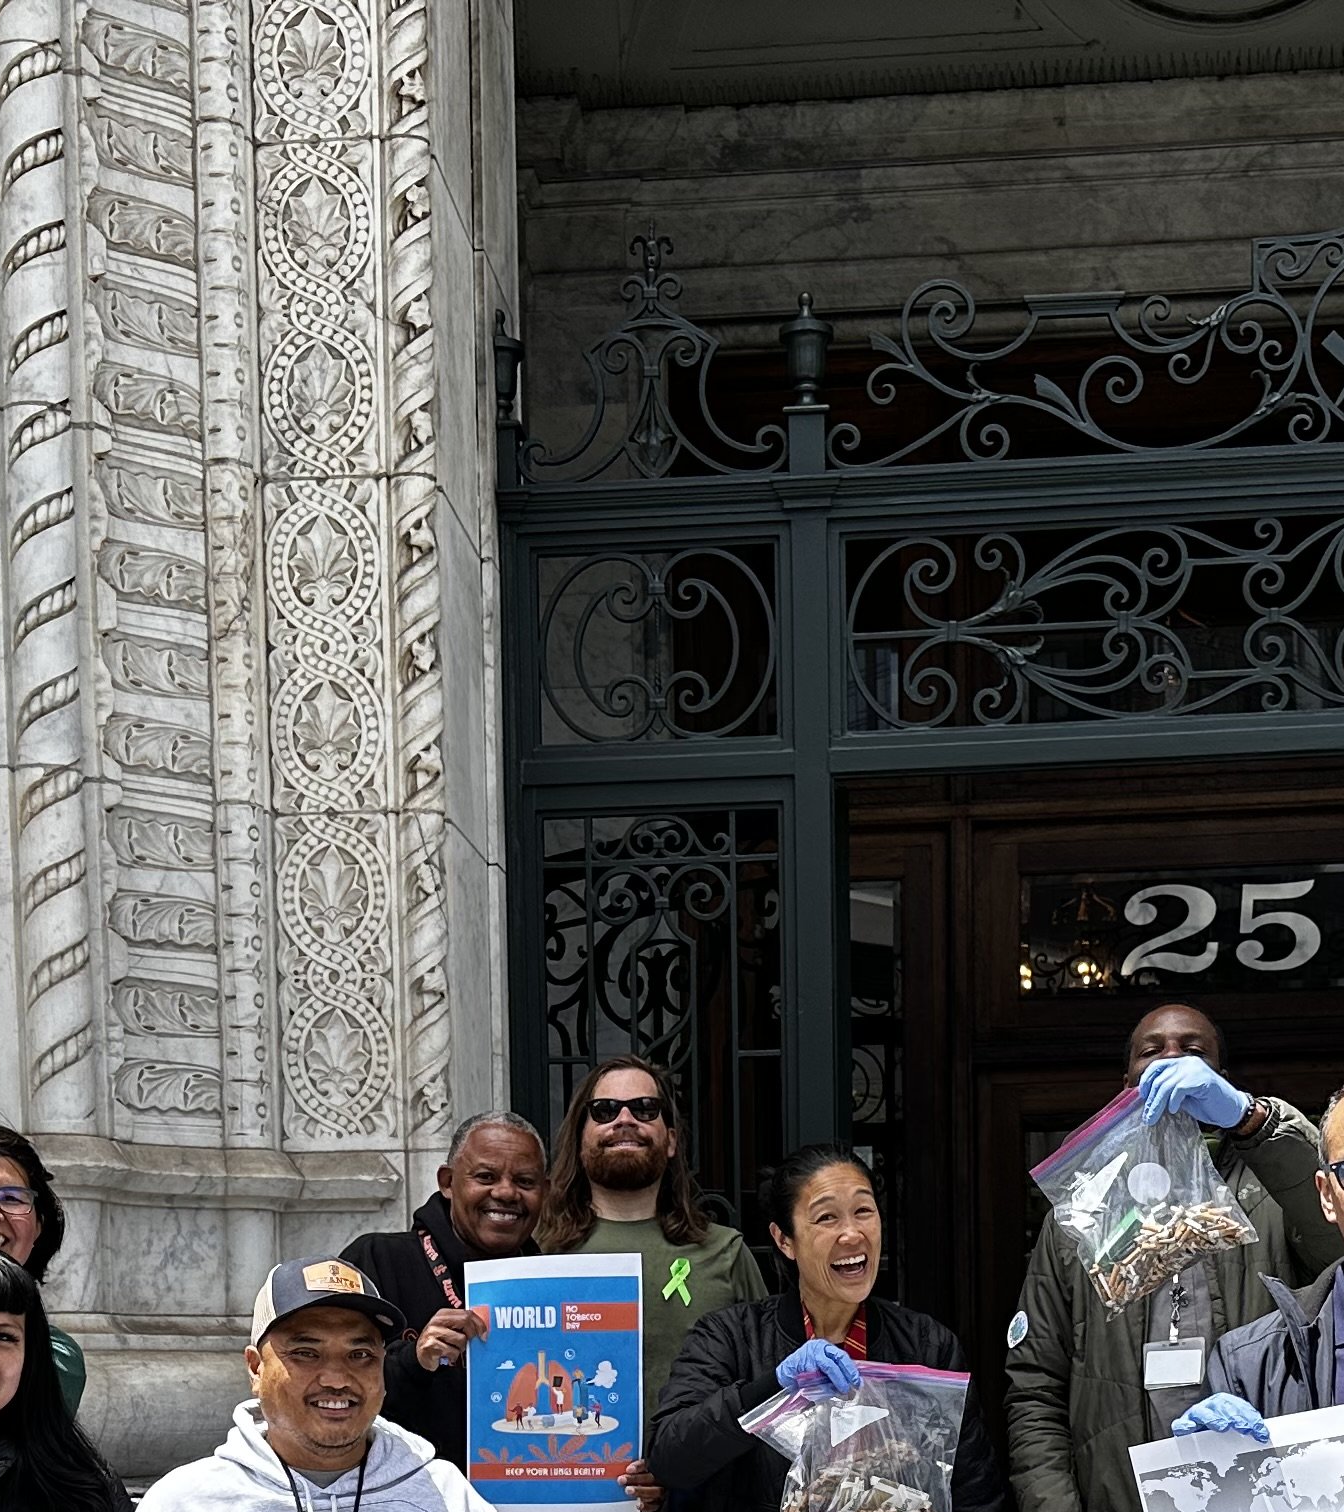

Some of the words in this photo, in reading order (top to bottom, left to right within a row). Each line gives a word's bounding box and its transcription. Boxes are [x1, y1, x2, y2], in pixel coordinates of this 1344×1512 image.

[1121, 879, 1321, 976] 25
[565, 1305, 578, 1314] NO
[494, 1305, 556, 1329] WORLD
[566, 1313, 602, 1322] TOBACCO
[505, 1467, 524, 1476] KEEP
[526, 1467, 548, 1476] YOUR
[550, 1467, 572, 1476] LUNGS
[573, 1467, 606, 1476] HEALTHY
